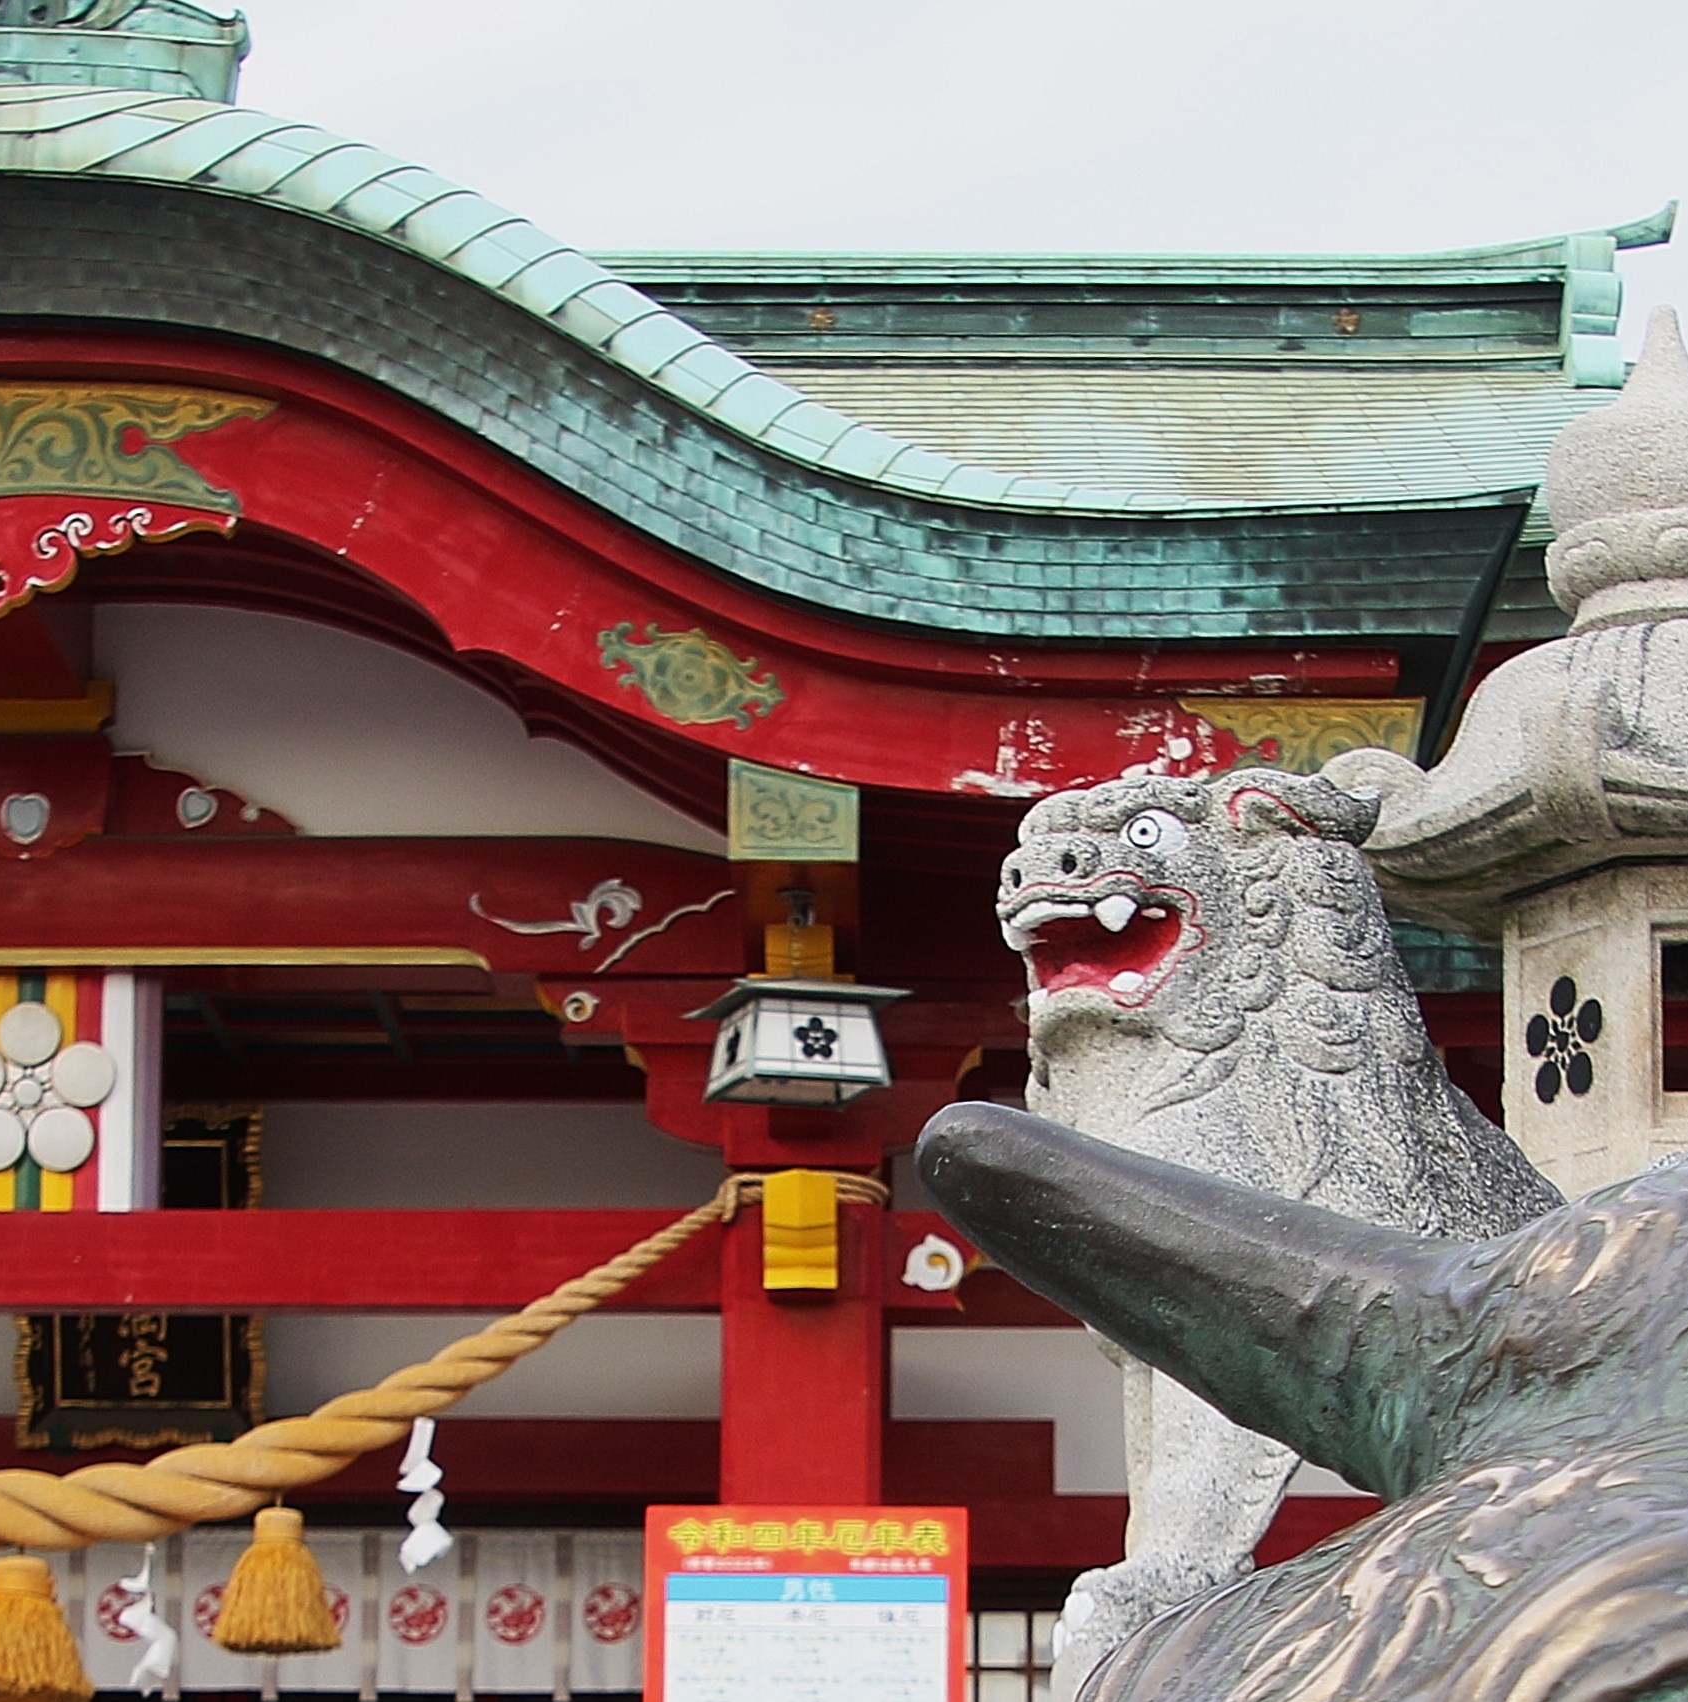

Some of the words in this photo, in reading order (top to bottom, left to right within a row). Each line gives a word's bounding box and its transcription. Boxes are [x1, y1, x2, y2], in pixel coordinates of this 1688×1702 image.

[667, 1517, 951, 1556] 令和四年厄年表
